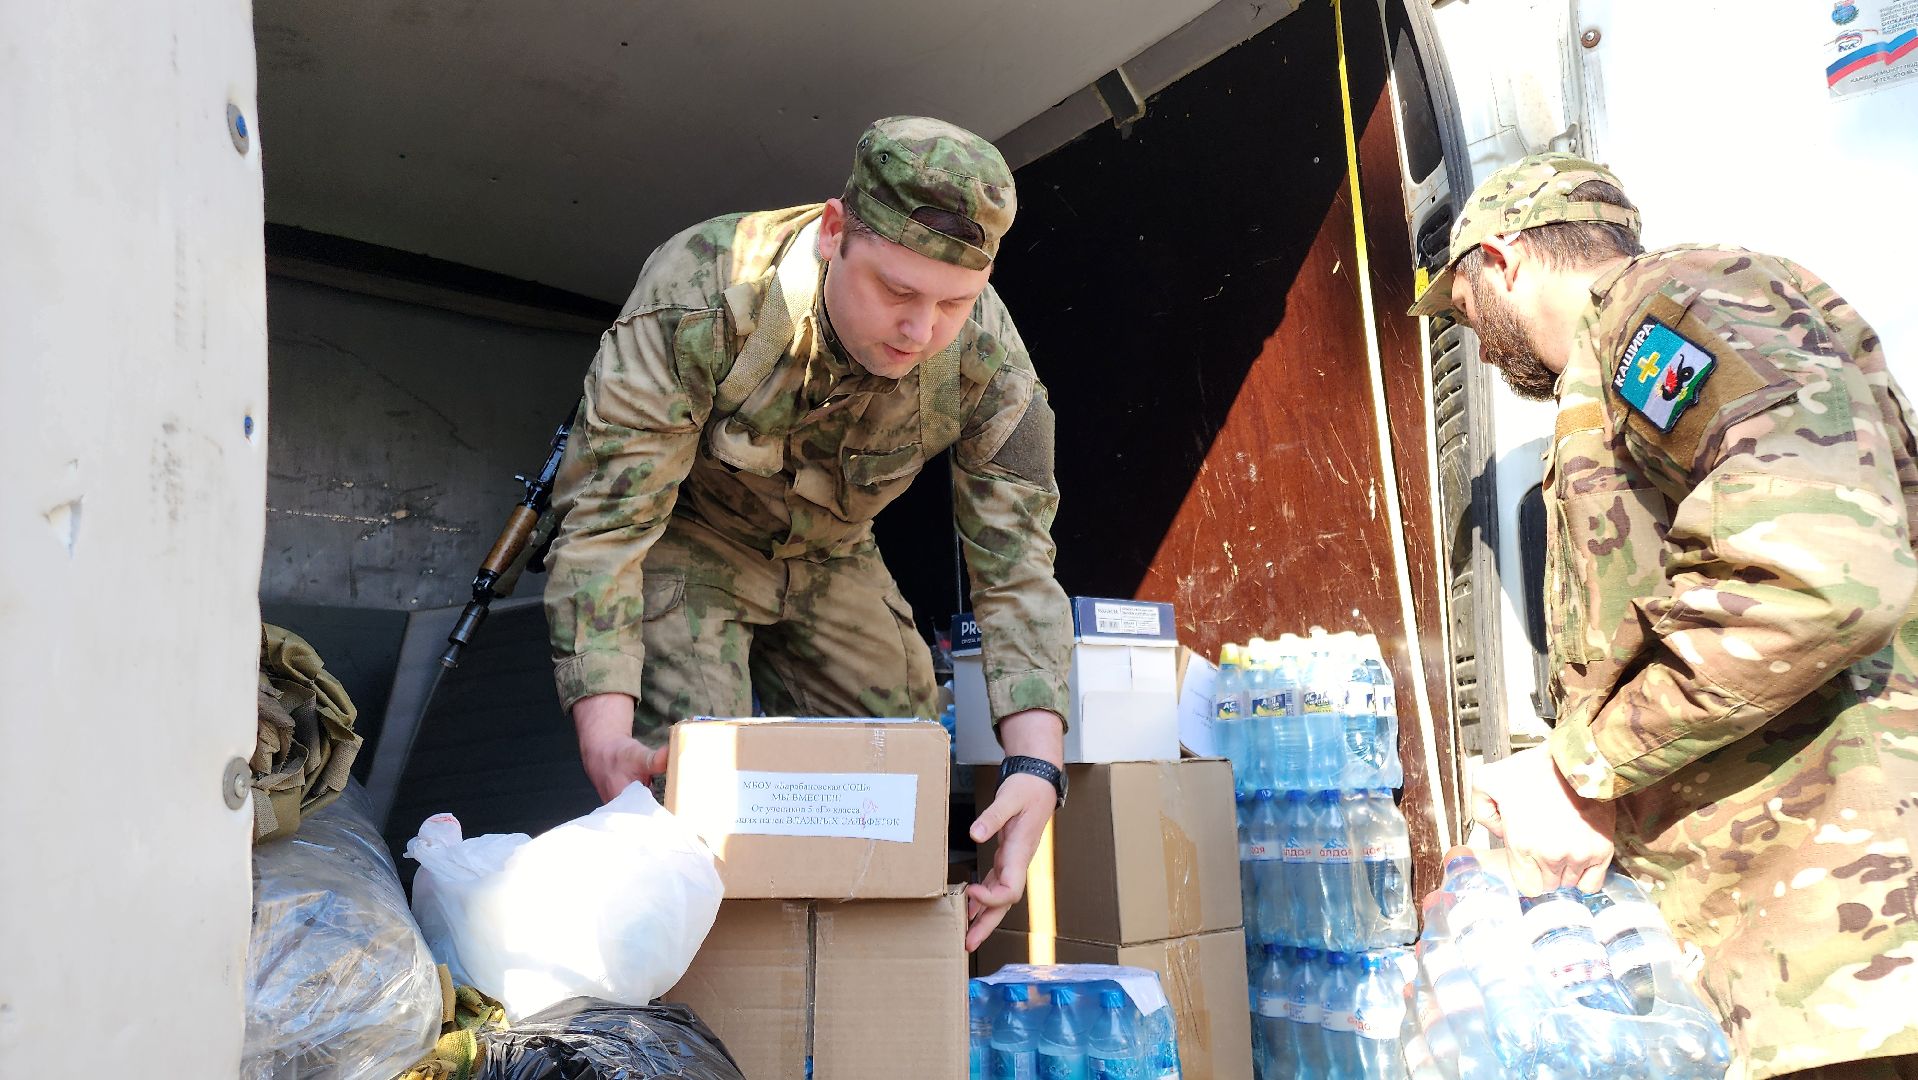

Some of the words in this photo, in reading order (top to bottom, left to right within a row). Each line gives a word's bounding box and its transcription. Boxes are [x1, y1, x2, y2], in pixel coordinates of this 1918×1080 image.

[1614, 322, 1656, 388] КАШИРА
[771, 793, 790, 801] МЫ
[751, 804, 764, 813] От
[766, 806, 806, 815] учеников
[807, 805, 813, 813] 5
[833, 807, 861, 815] класса
